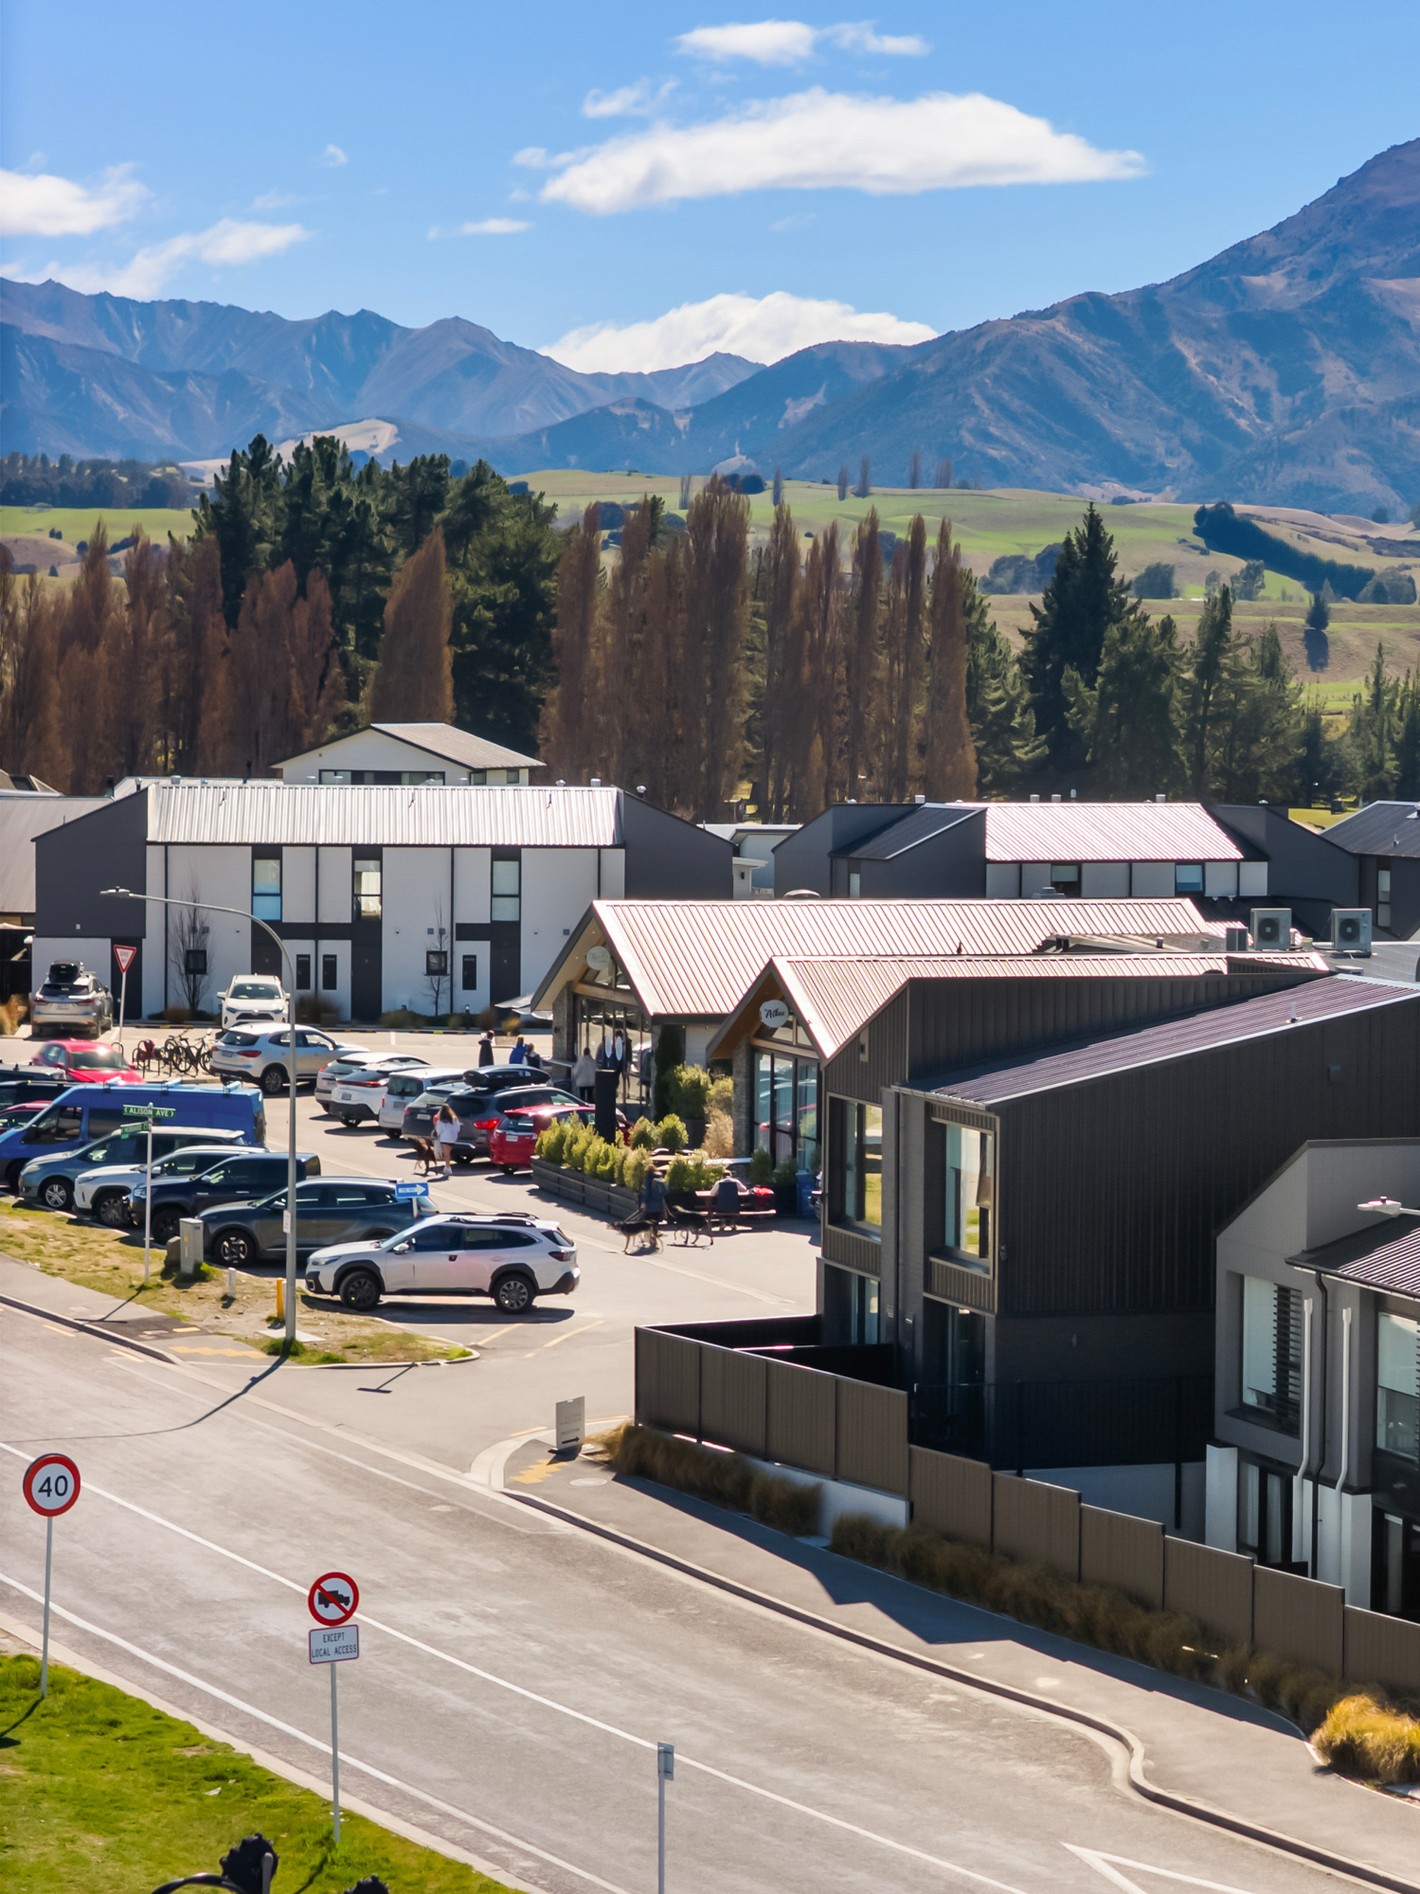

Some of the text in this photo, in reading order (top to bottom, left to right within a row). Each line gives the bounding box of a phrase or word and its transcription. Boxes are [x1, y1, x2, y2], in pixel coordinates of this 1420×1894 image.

[129, 1107, 169, 1117] ALISON AVE
[38, 1475, 68, 1498] 40
[323, 1632, 344, 1643] EXCEPT
[312, 1644, 356, 1658] LOCAL ACCESS
